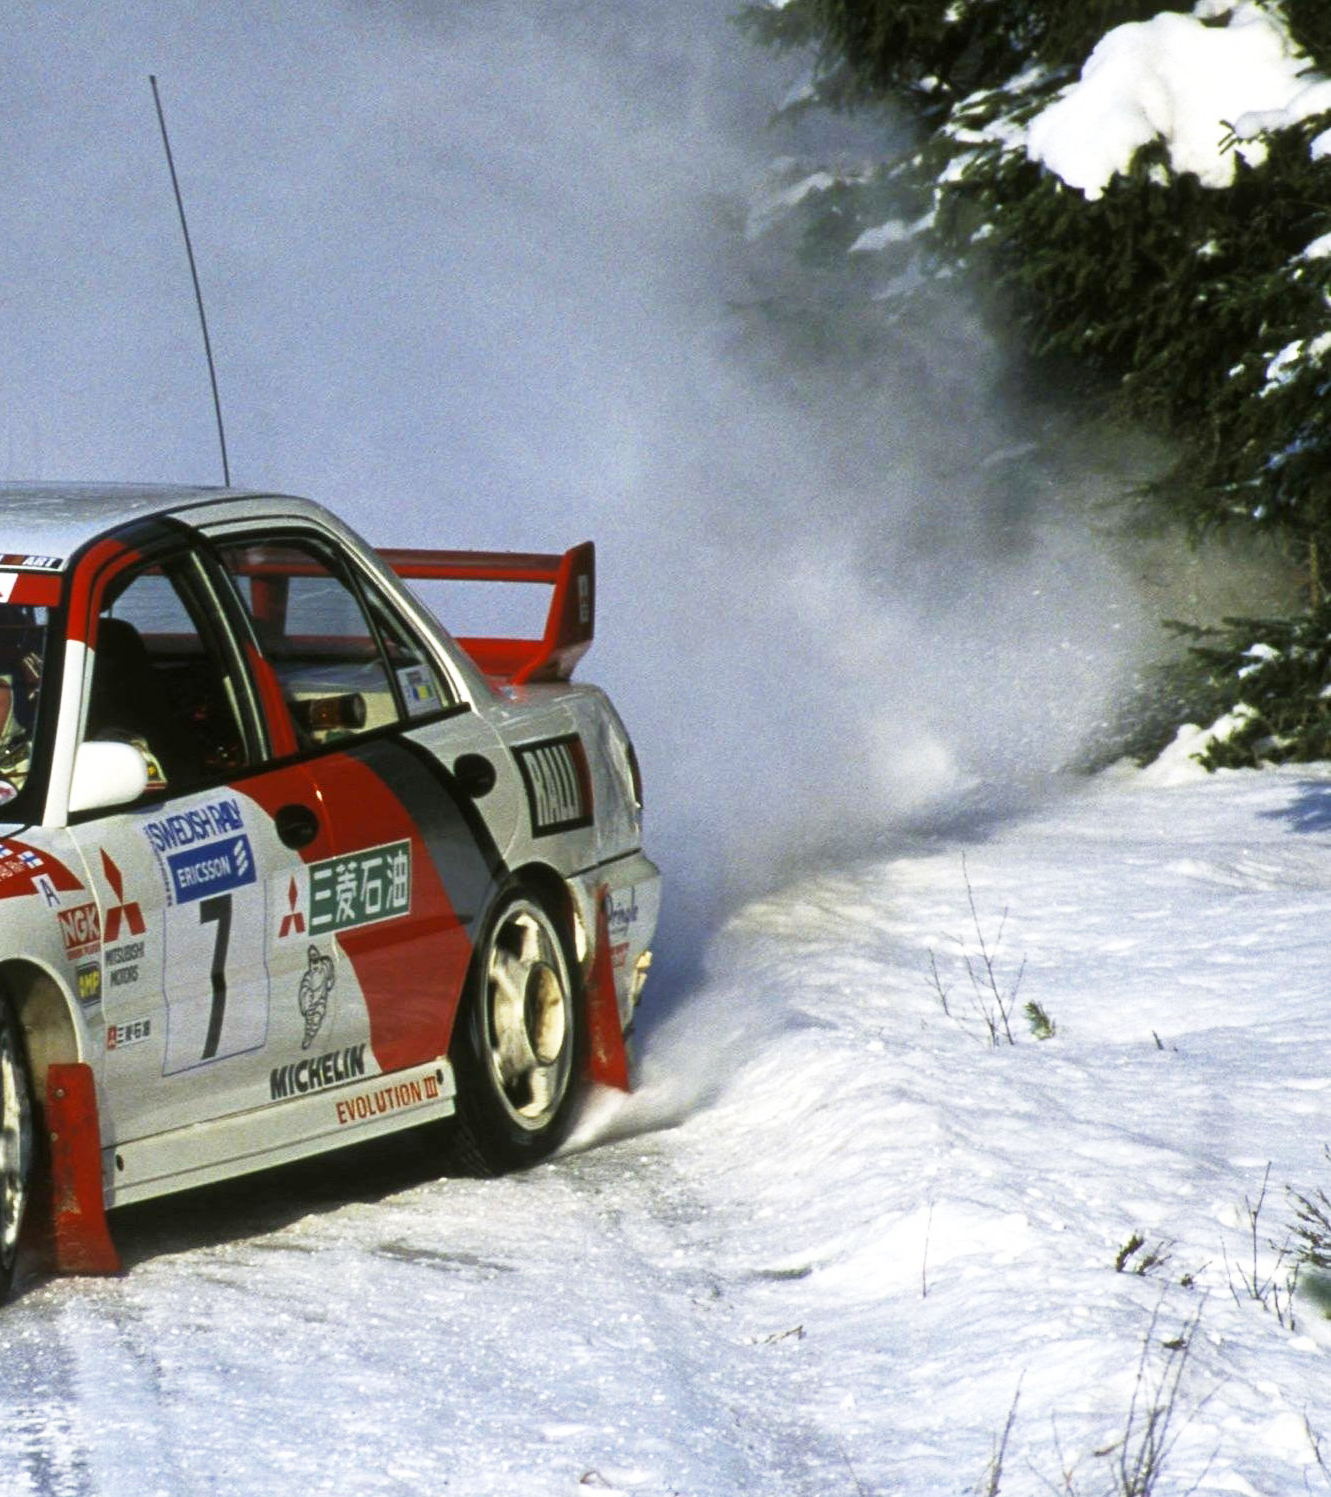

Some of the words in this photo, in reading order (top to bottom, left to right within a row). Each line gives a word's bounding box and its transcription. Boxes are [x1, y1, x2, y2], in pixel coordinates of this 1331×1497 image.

[145, 808, 217, 852] SWEDISH
[39, 877, 61, 907] A
[176, 855, 232, 888] ERICSSON
[311, 849, 408, 926] 三菱石油
[59, 905, 101, 946] NGK
[199, 893, 232, 1060] 7
[270, 1043, 366, 1100] MICHELIN
[335, 1080, 423, 1125] EVOLUTION
